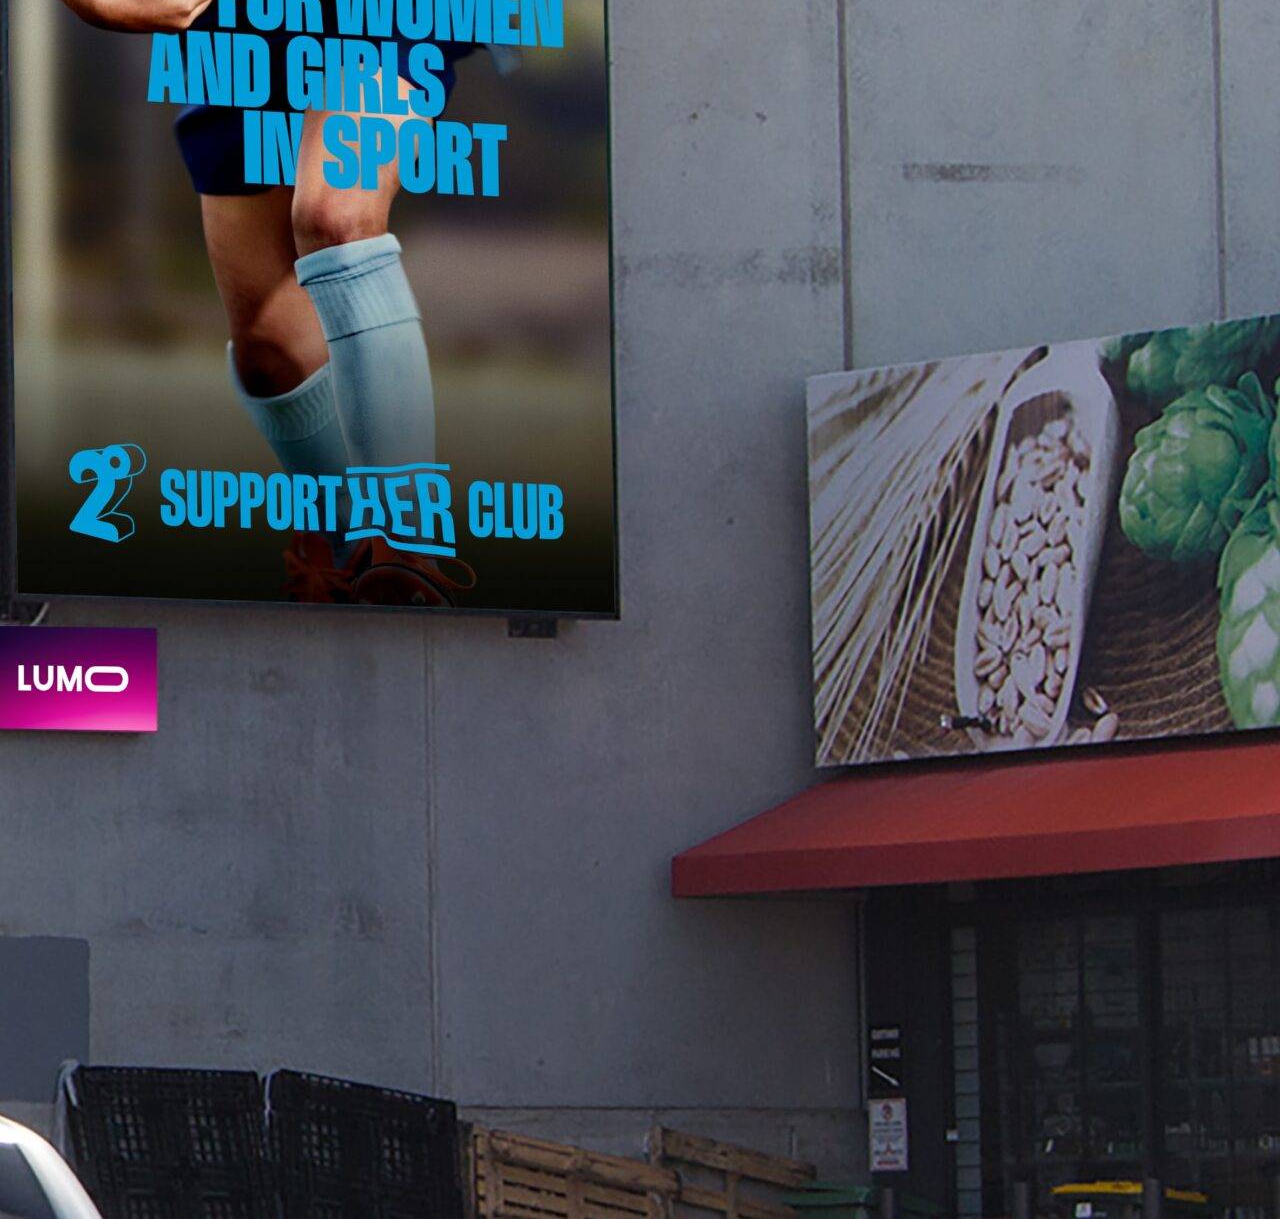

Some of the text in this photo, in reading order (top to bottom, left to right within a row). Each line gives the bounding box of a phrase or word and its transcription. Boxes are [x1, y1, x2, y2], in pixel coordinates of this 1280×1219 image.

[147, 30, 445, 117] AND GIRLS
[243, 110, 507, 197] IN SPORT
[468, 481, 564, 540] CLUB
[17, 664, 130, 693] LUMO
